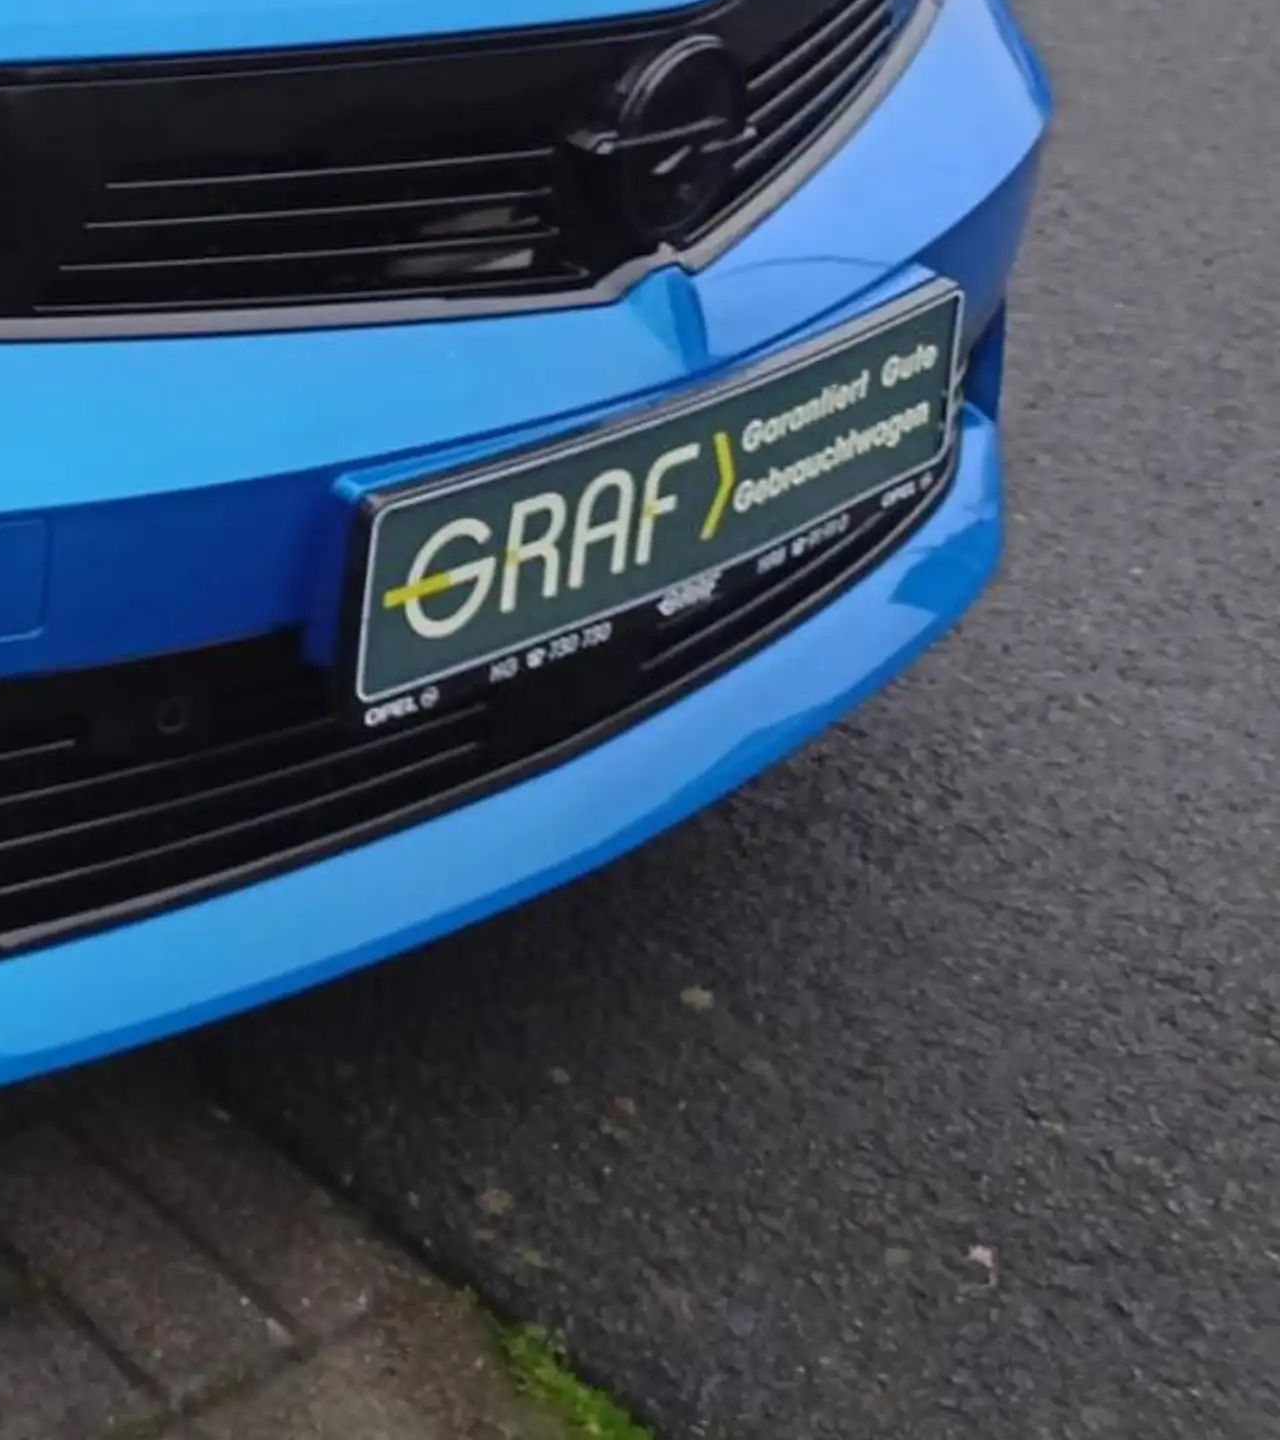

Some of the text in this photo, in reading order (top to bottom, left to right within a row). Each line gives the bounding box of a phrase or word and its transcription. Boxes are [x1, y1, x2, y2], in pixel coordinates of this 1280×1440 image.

[742, 343, 938, 453] Garantiert Gute
[733, 401, 931, 513] Gebrauchtwagen
[383, 442, 701, 639] GRAF
